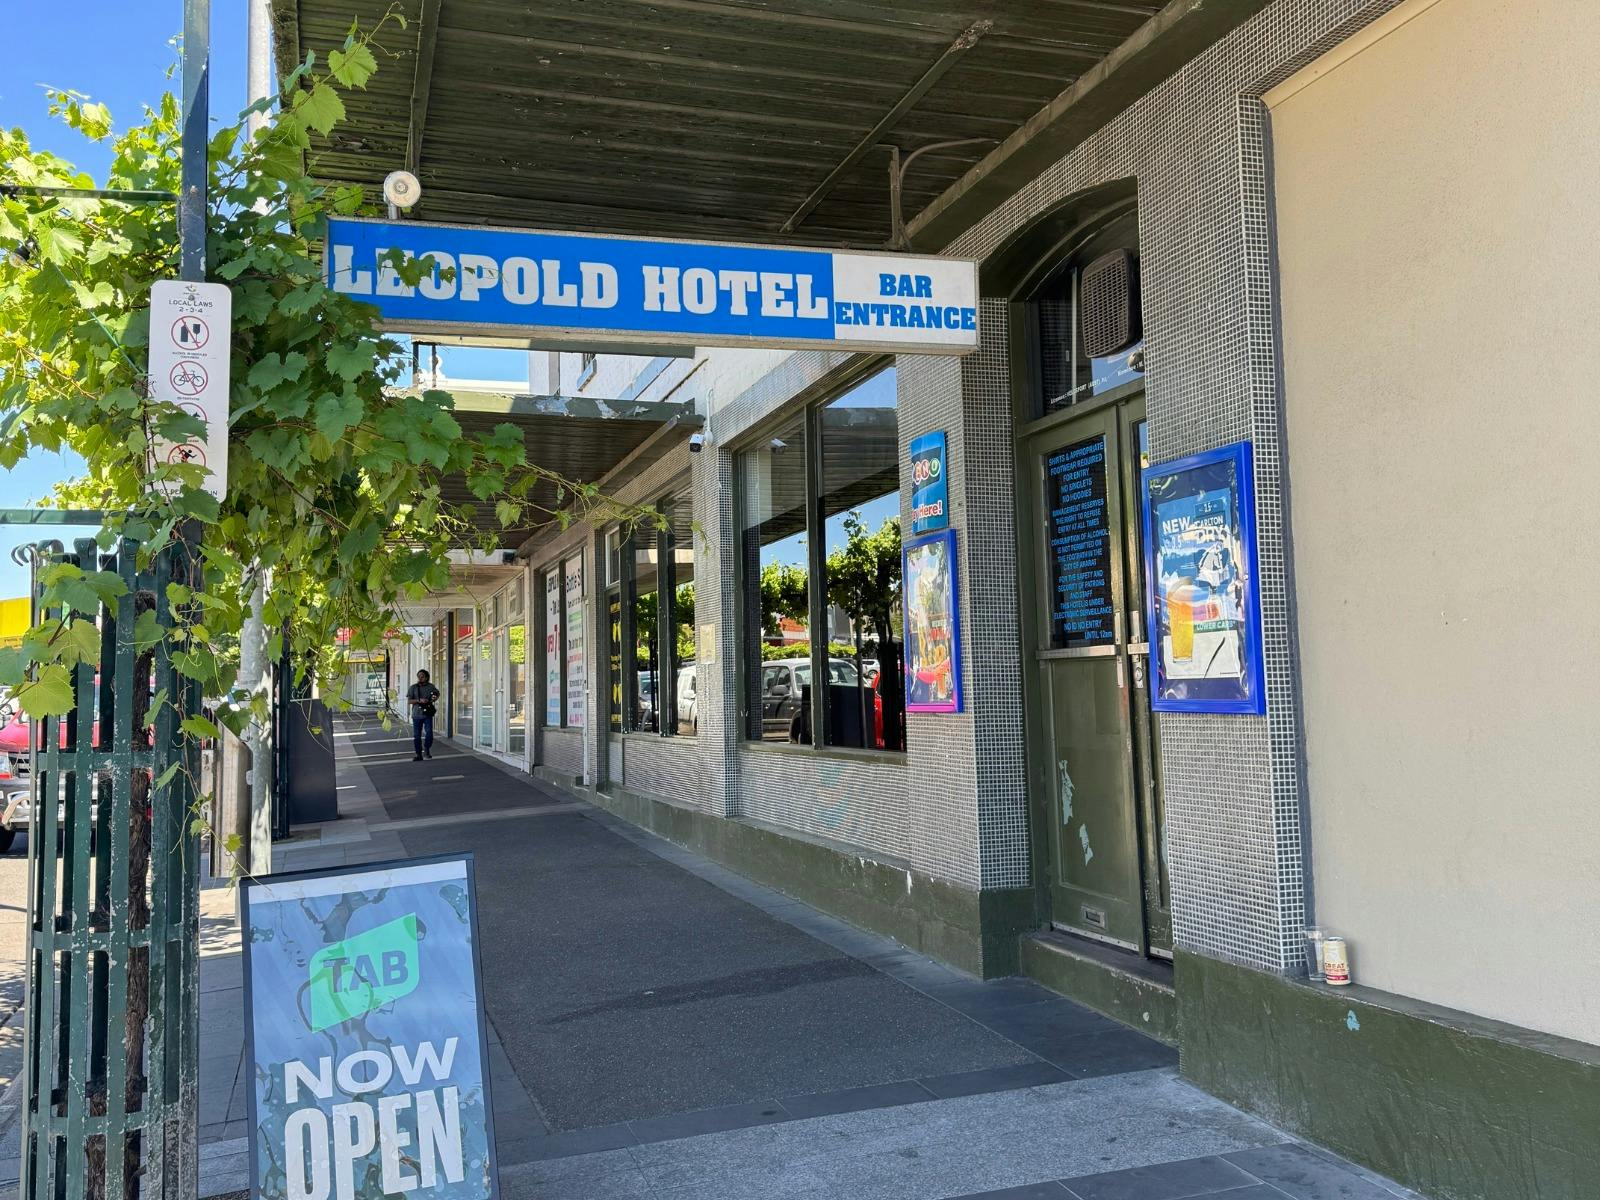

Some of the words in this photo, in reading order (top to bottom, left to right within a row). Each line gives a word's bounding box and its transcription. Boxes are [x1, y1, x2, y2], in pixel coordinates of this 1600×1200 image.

[333, 245, 618, 308] LEOPOLD
[642, 265, 828, 319] HOTEL
[879, 274, 932, 298] BAR
[835, 302, 976, 330] ENTRANCE
[1049, 454, 1065, 466] SHIRTS
[1070, 442, 1104, 460] APPROPRIATE
[1050, 461, 1076, 476] FOOTWEAR
[1077, 453, 1102, 468] REQUIRED
[1063, 473, 1074, 482] FOR
[1074, 468, 1090, 480] ENTRY
[1061, 484, 1068, 494] NO
[1069, 478, 1092, 490] SINGLETS
[1062, 494, 1069, 503] NO
[1070, 488, 1092, 502] HOODIES
[920, 501, 942, 518] Here!
[1052, 504, 1080, 517] MANAGEMENT
[1081, 498, 1104, 510] RESERVES
[1084, 508, 1101, 518] REFUSE
[1058, 524, 1071, 534] ENTRY
[1086, 518, 1099, 526] TIMES
[1163, 516, 1190, 535] NEW
[1194, 515, 1223, 528] CARLTON
[1051, 535, 1080, 546] CONSUMPTION
[1088, 528, 1108, 538] ALCOHOL
[1071, 540, 1094, 551] PERMITTED
[1077, 571, 1093, 580] SAFETY
[1089, 598, 1104, 606] UNDER
[1080, 606, 1112, 616] SURVEILLANCE
[1086, 619, 1102, 628] ENTRY
[1196, 622, 1216, 630] LOWER
[1084, 630, 1099, 640] UNTIL
[323, 950, 408, 994] TAB
[284, 1037, 458, 1104] NOW
[285, 1086, 465, 1200] OPEN
